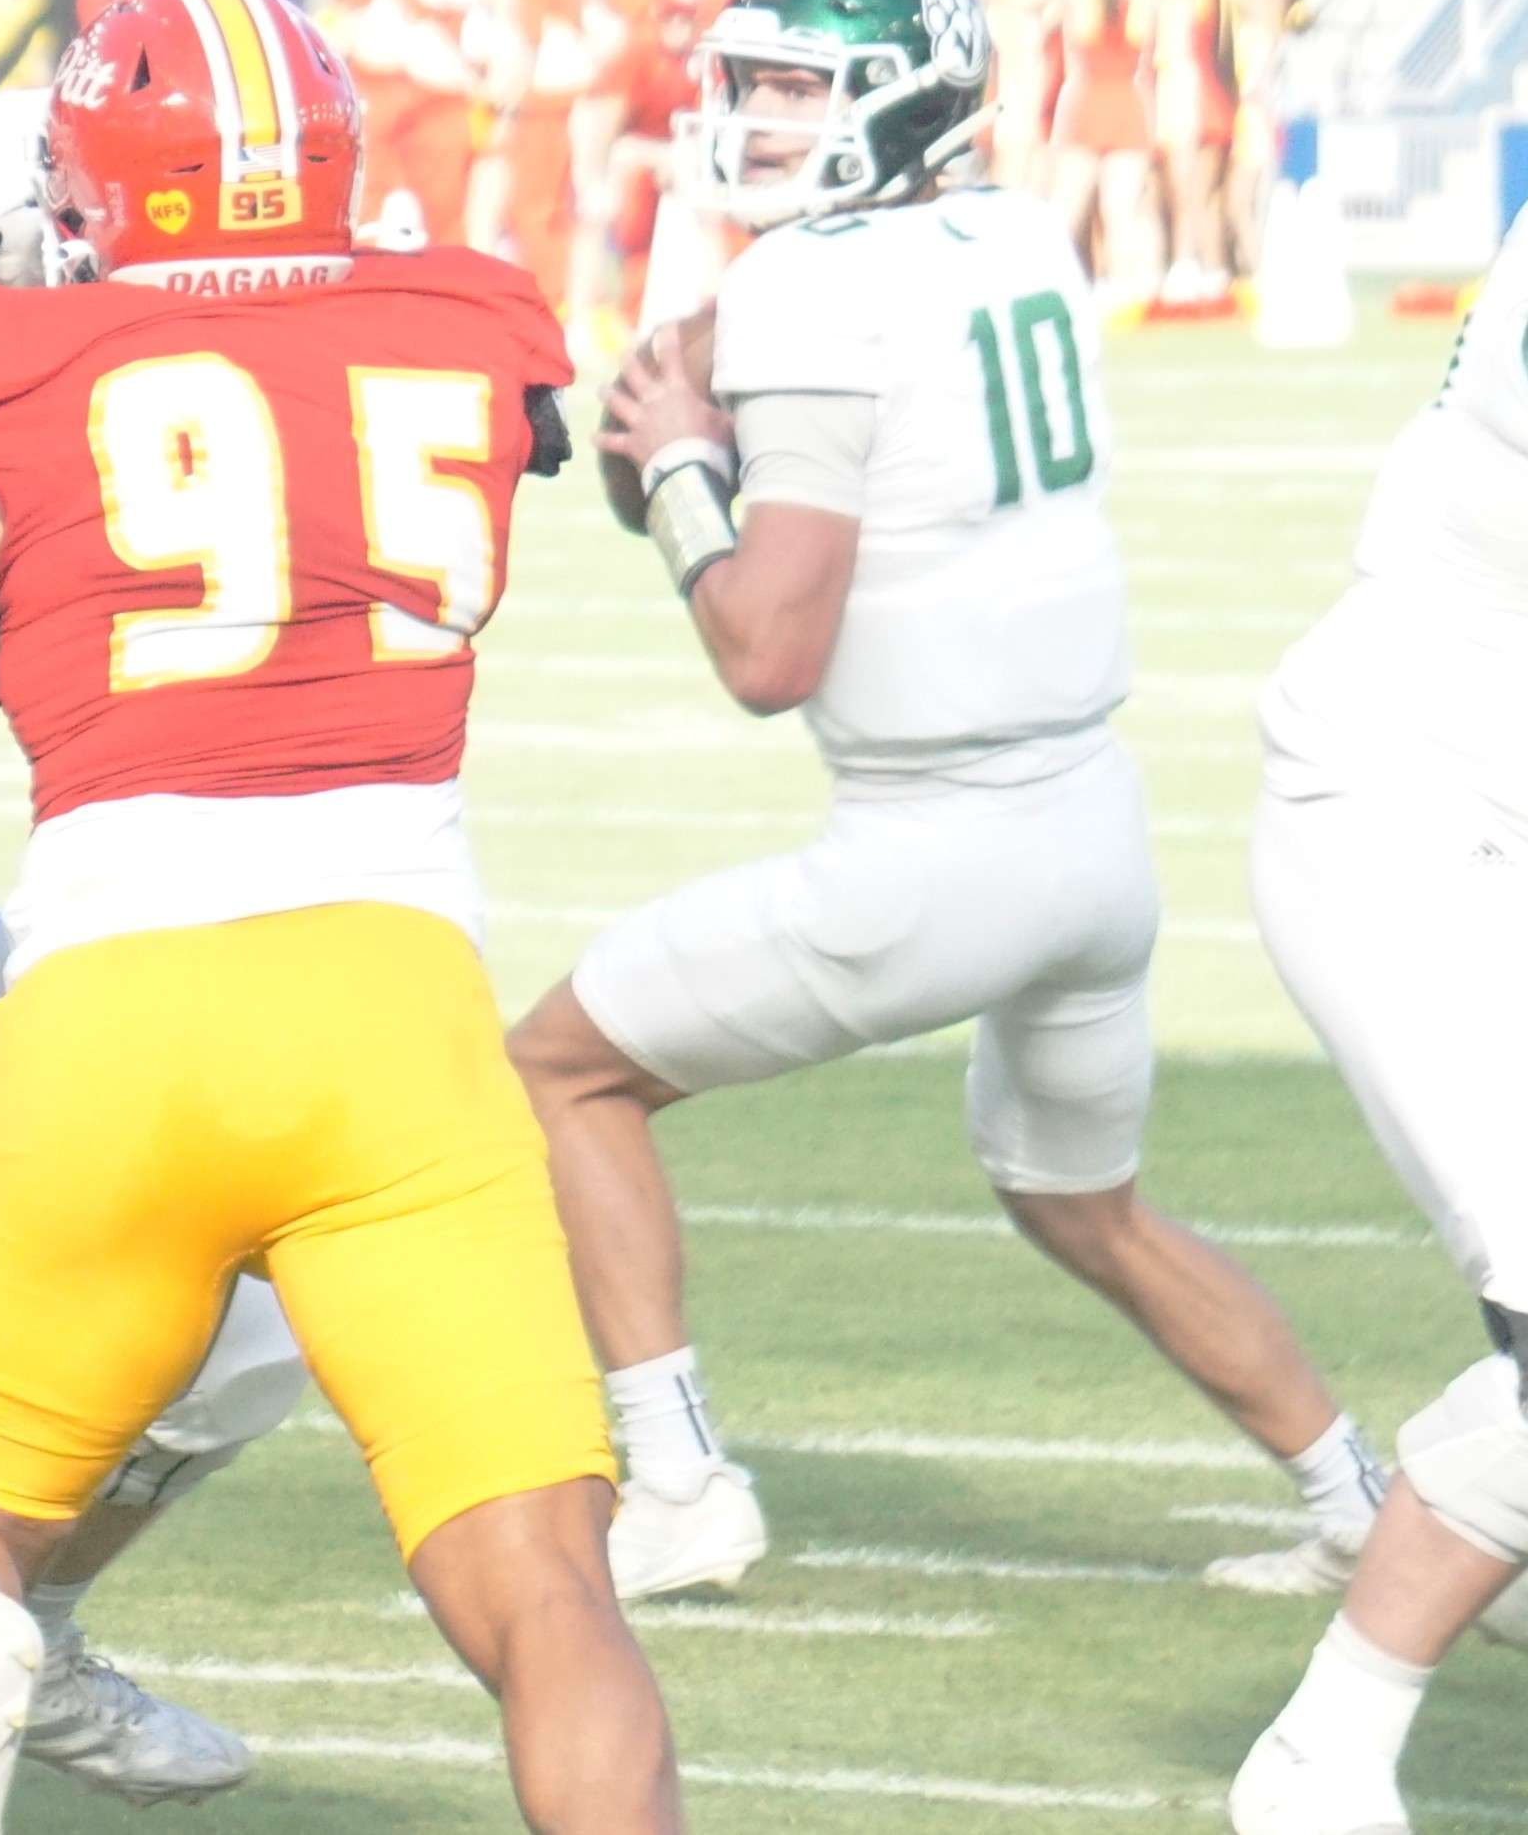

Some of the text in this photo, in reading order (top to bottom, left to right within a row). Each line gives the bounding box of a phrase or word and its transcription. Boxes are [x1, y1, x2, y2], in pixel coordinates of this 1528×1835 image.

[232, 187, 286, 222] 95
[967, 287, 1095, 511] 10
[87, 350, 496, 697] 95
